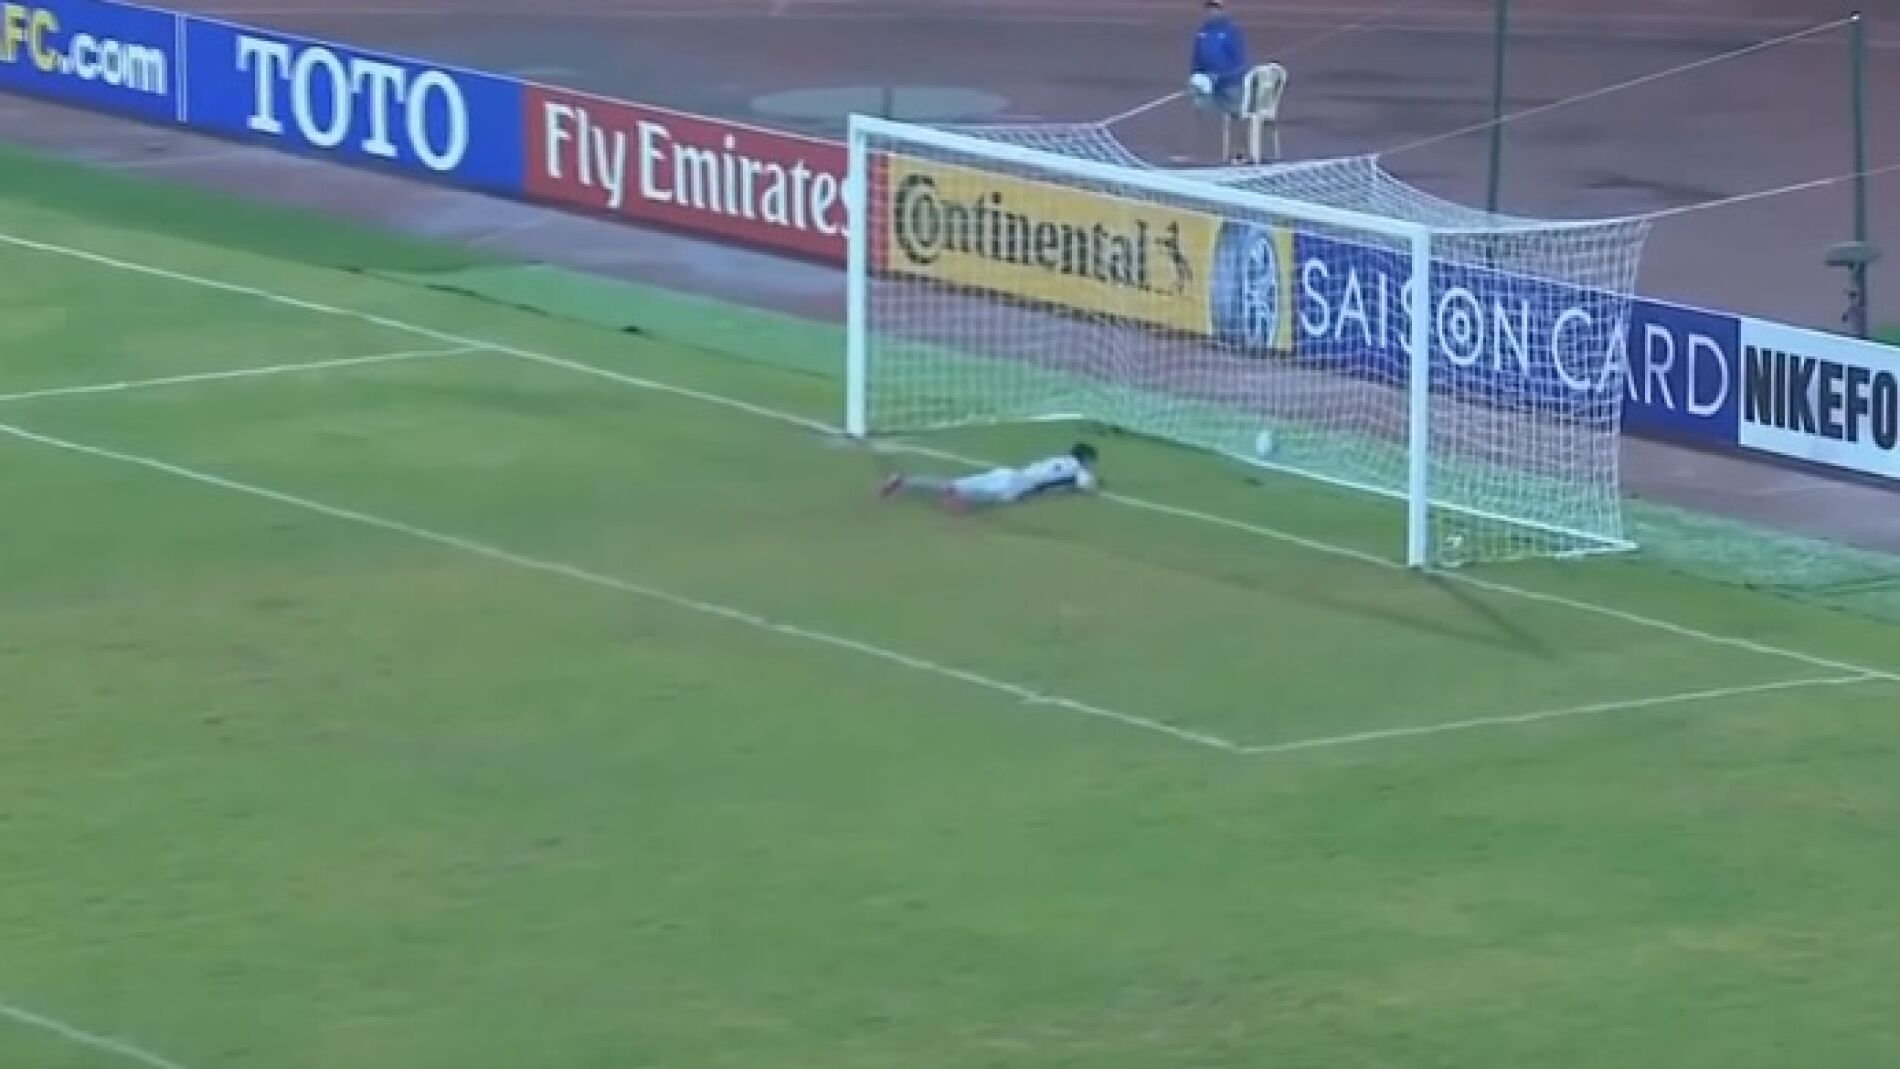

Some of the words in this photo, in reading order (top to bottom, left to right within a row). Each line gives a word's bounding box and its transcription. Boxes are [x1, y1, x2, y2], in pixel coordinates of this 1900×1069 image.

[236, 35, 469, 171] TOTO
[545, 101, 627, 208] Fly
[894, 174, 1151, 292] Continental
[1551, 308, 1729, 416] CARD
[1745, 345, 1899, 450] NIKEFO
